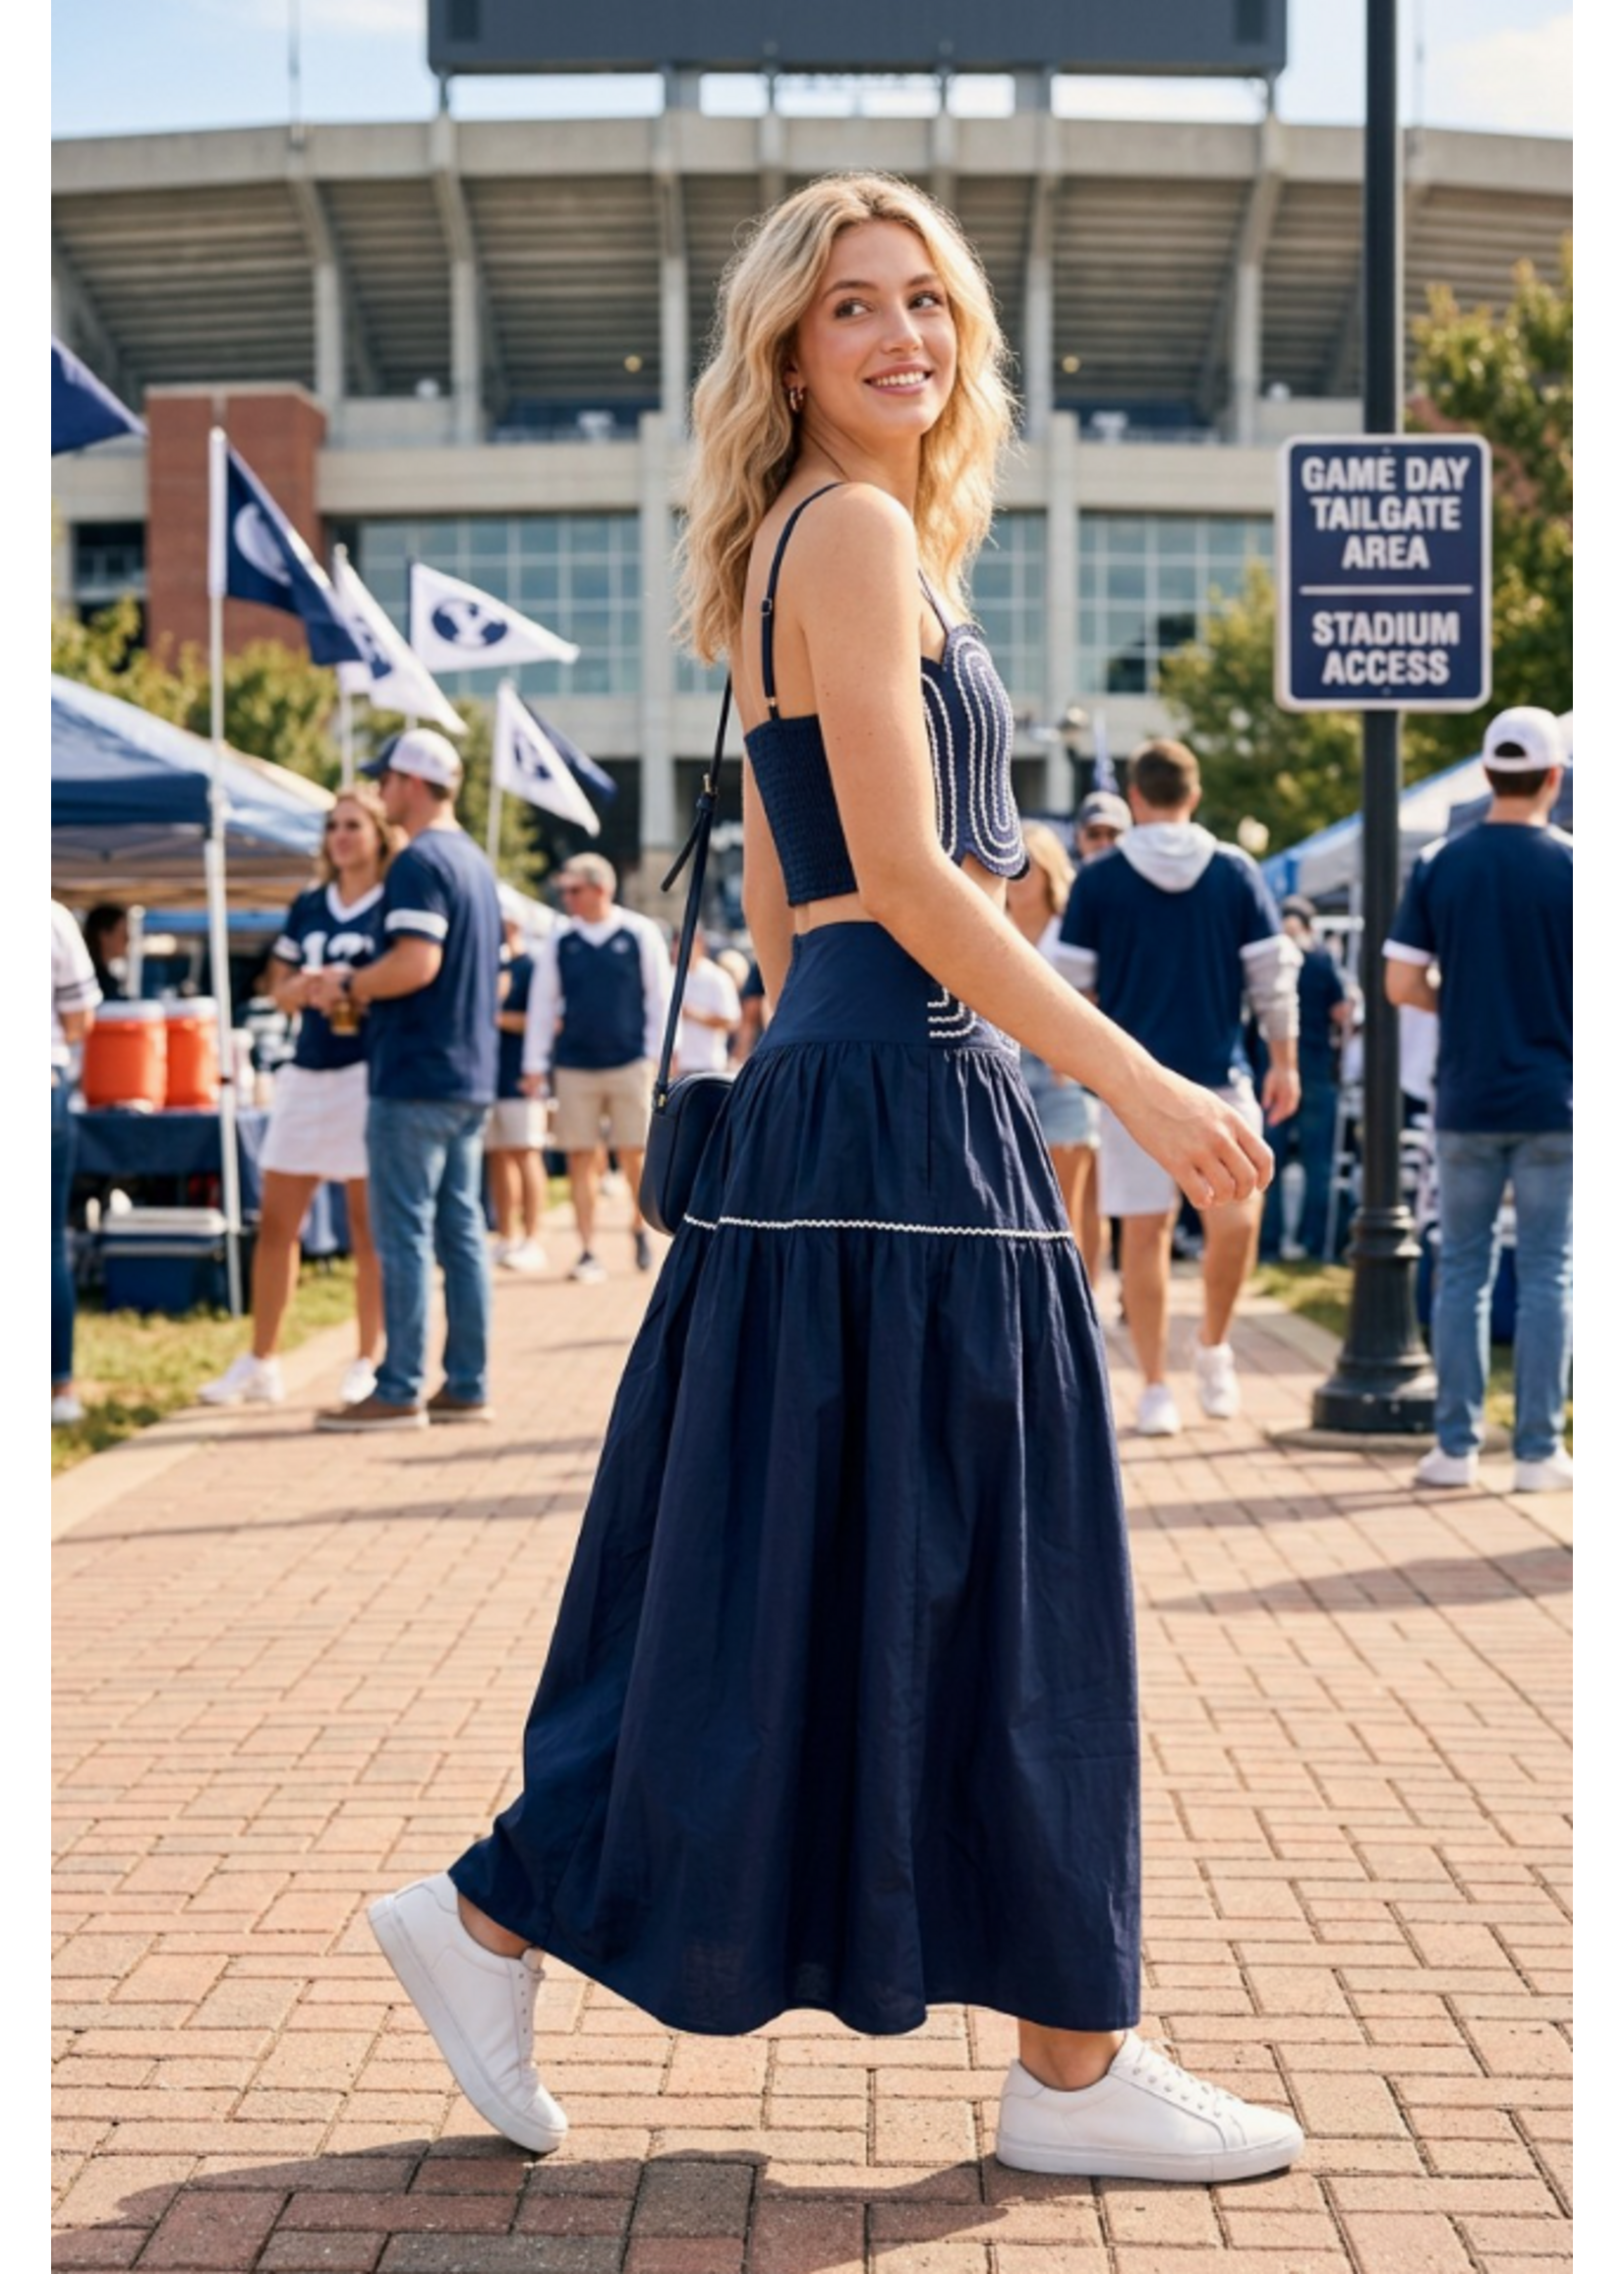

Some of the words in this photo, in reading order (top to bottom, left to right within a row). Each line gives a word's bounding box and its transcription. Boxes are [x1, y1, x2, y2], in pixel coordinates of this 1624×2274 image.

[1301, 457, 1396, 492] GAME
[1405, 457, 1471, 491] DAY
[1310, 496, 1462, 530] TAILGATE
[1342, 536, 1430, 569] AREA
[1312, 612, 1460, 646] STADIUM
[1321, 650, 1450, 685] ACCESS
